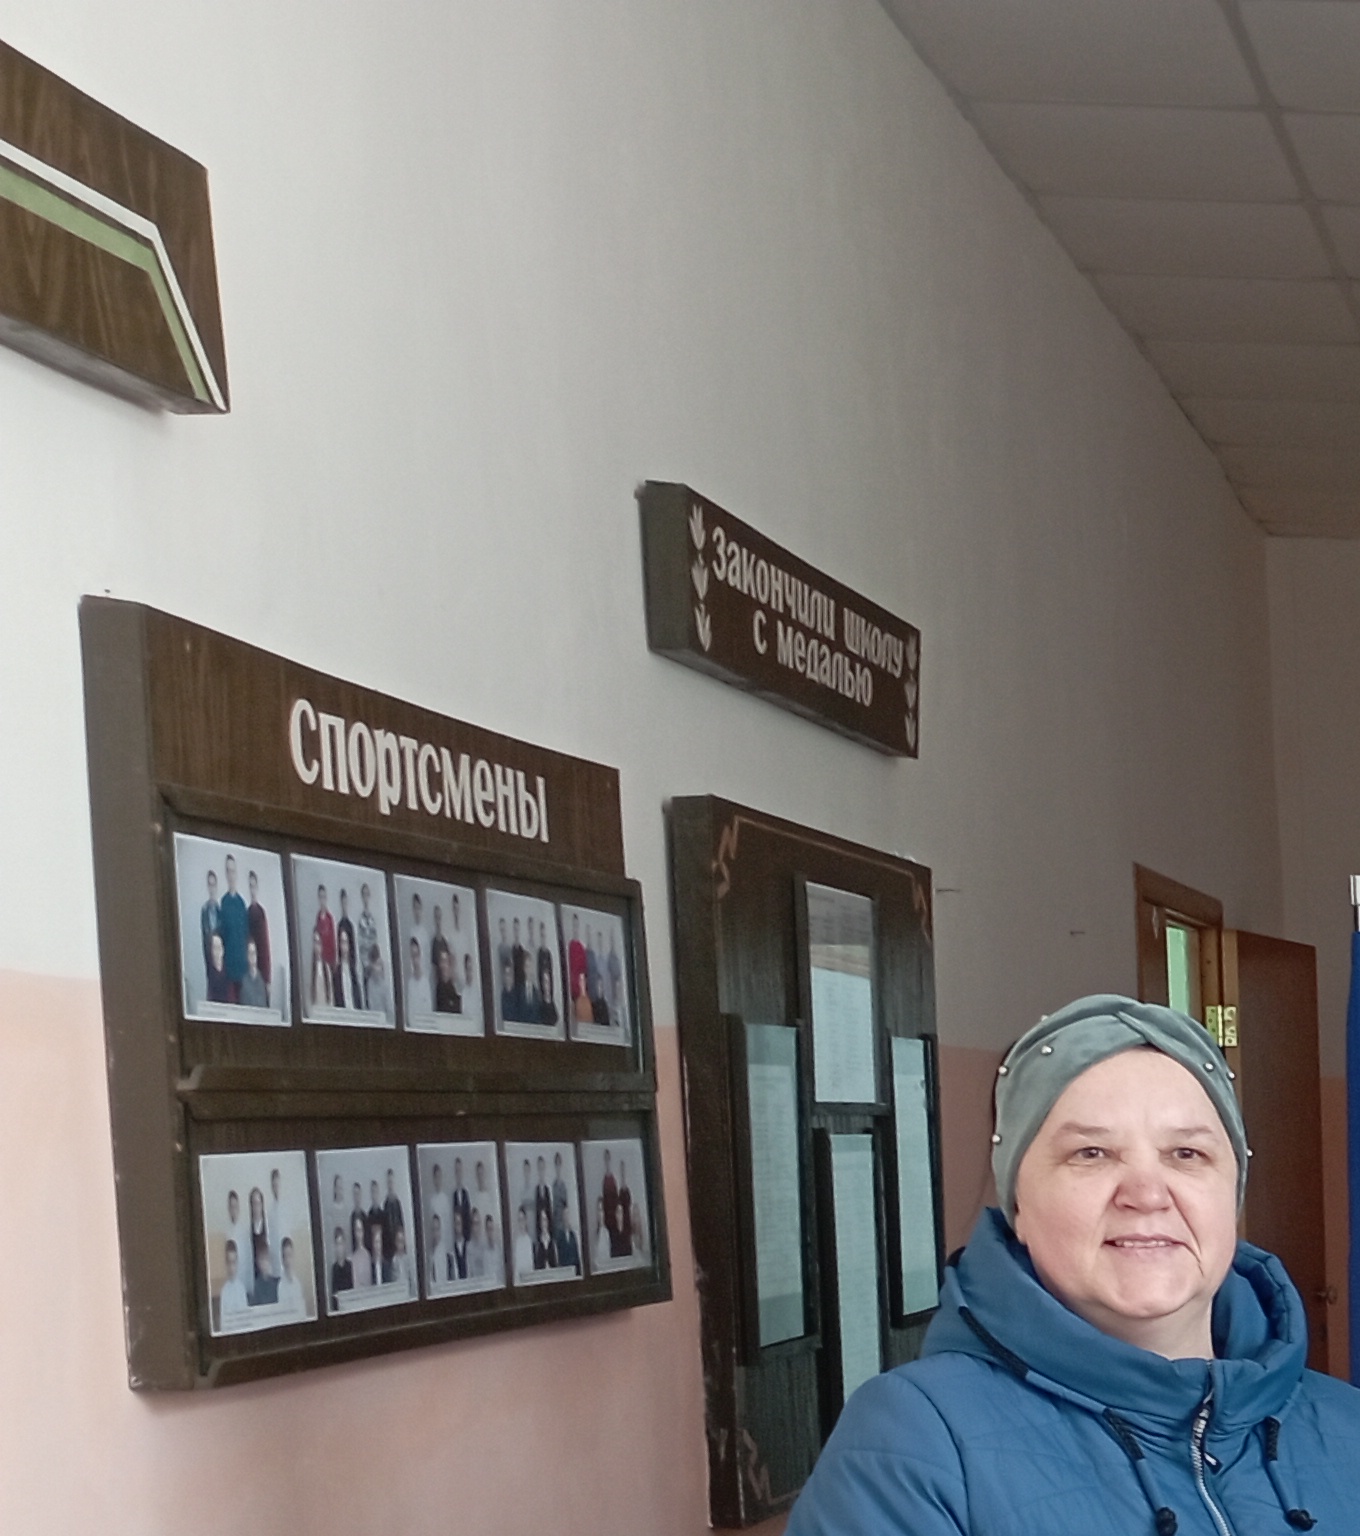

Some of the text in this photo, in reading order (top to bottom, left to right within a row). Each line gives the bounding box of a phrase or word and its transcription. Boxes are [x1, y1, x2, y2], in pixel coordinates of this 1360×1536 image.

[712, 526, 904, 679] Закончили школу
[776, 620, 874, 707] медалью
[289, 698, 550, 844] Спортсмены
